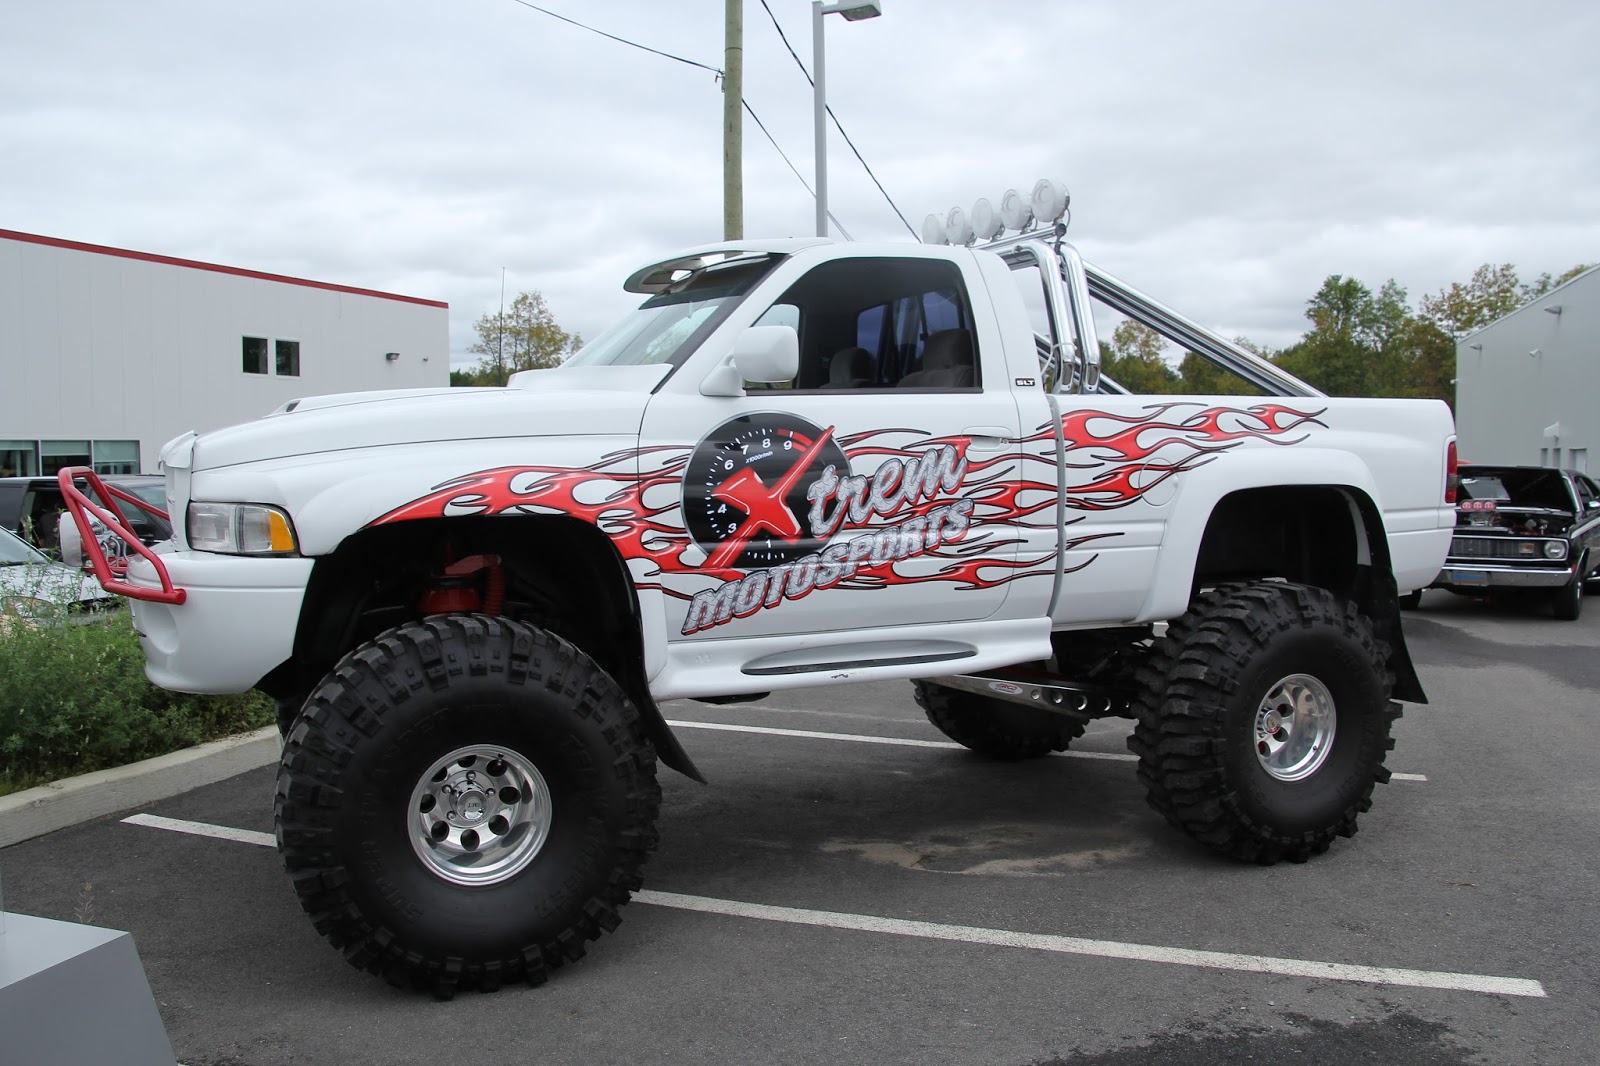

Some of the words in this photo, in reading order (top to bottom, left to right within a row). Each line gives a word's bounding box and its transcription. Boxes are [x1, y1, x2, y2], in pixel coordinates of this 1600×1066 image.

[762, 438, 771, 448] 8
[783, 440, 793, 450] 9
[741, 444, 749, 455] 7
[724, 459, 734, 470] 6
[717, 503, 727, 514] 4
[727, 523, 737, 533] 3
[765, 539, 772, 548] 1
[681, 498, 974, 636] MOTOSPORTS
